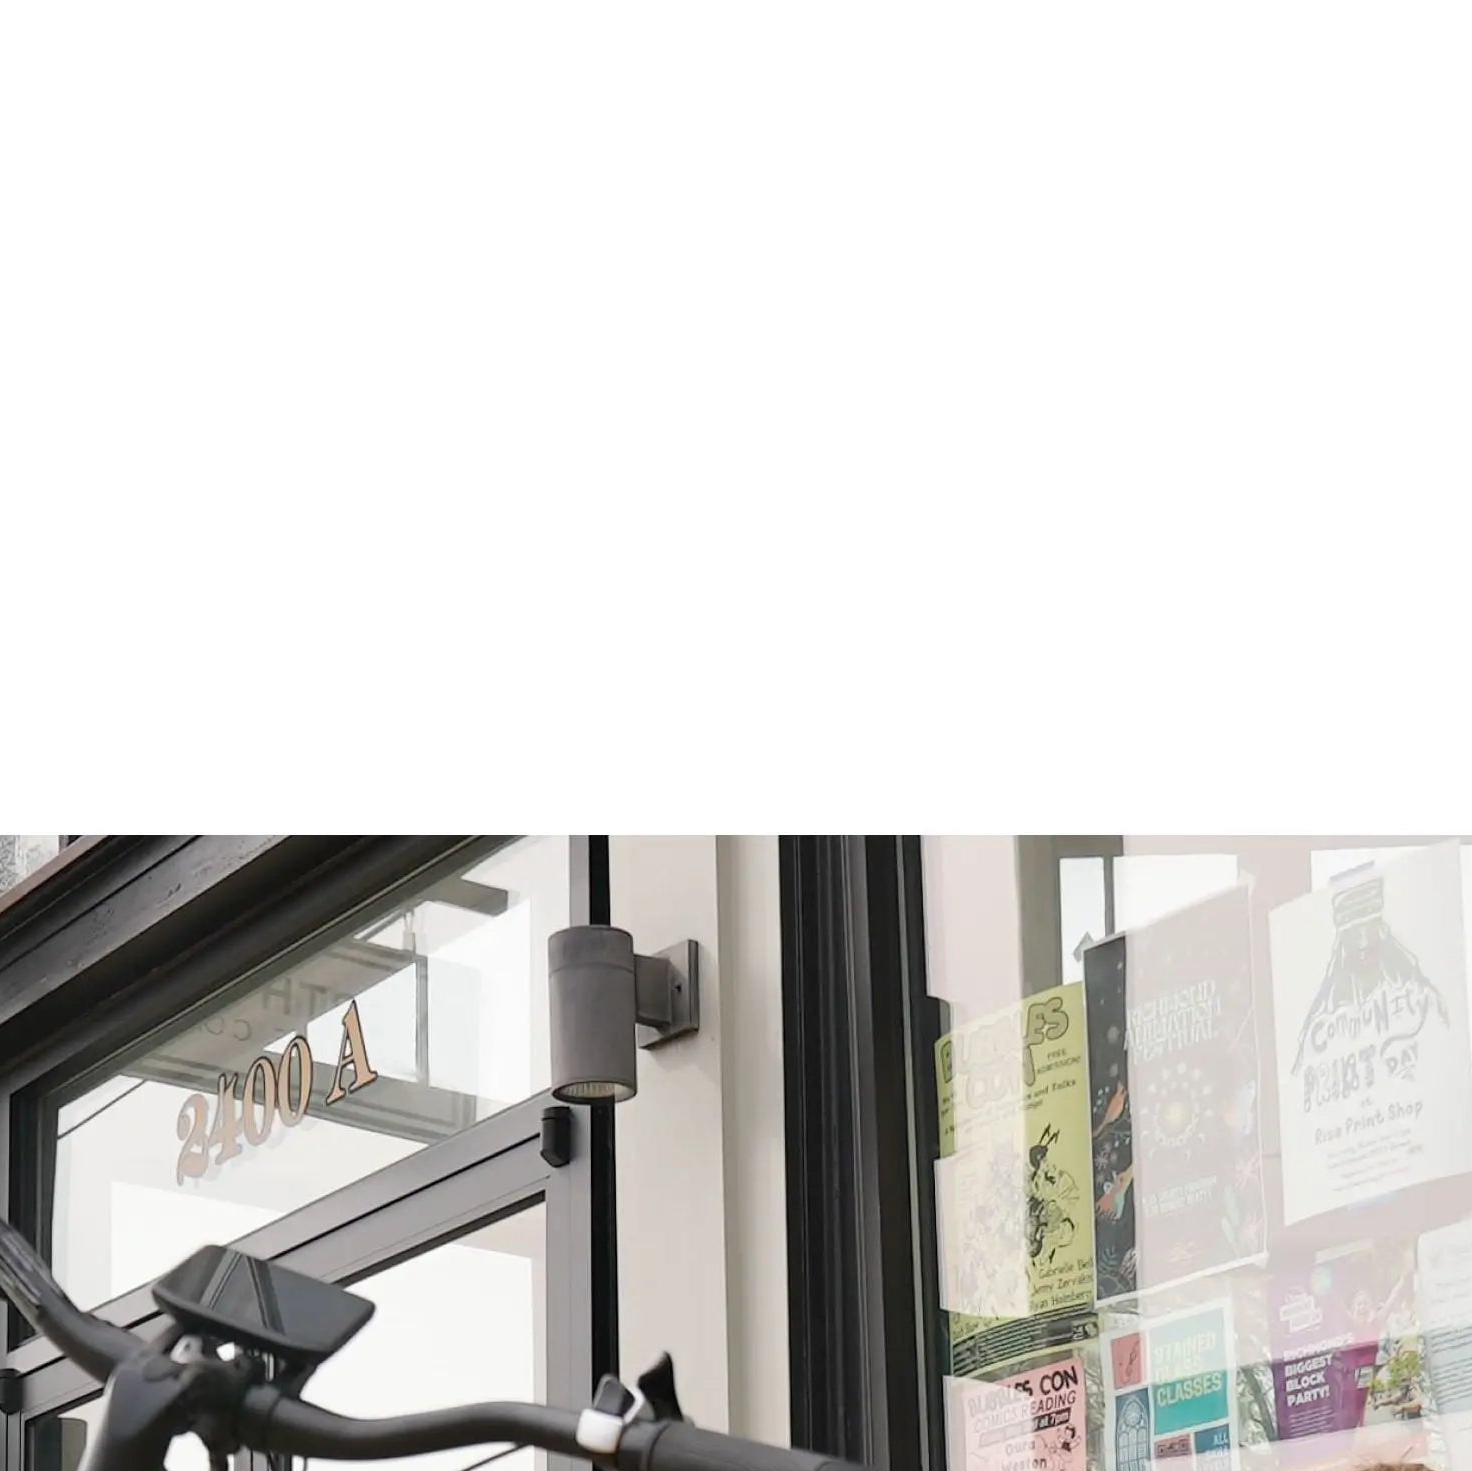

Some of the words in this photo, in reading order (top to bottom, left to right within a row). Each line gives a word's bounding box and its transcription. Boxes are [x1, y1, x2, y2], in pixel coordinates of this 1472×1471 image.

[176, 1034, 314, 1188] 2400
[326, 999, 378, 1104] A
[1344, 1111, 1385, 1135] Print
[1387, 1100, 1424, 1121] Shop
[1039, 1364, 1079, 1396] CON
[1285, 1354, 1333, 1377] BIGGEST
[1155, 1371, 1222, 1408] CLASSES
[1286, 1371, 1326, 1392] BLOCK
[1287, 1385, 1330, 1407] PARTY!
[1020, 1388, 1077, 1418] READING
